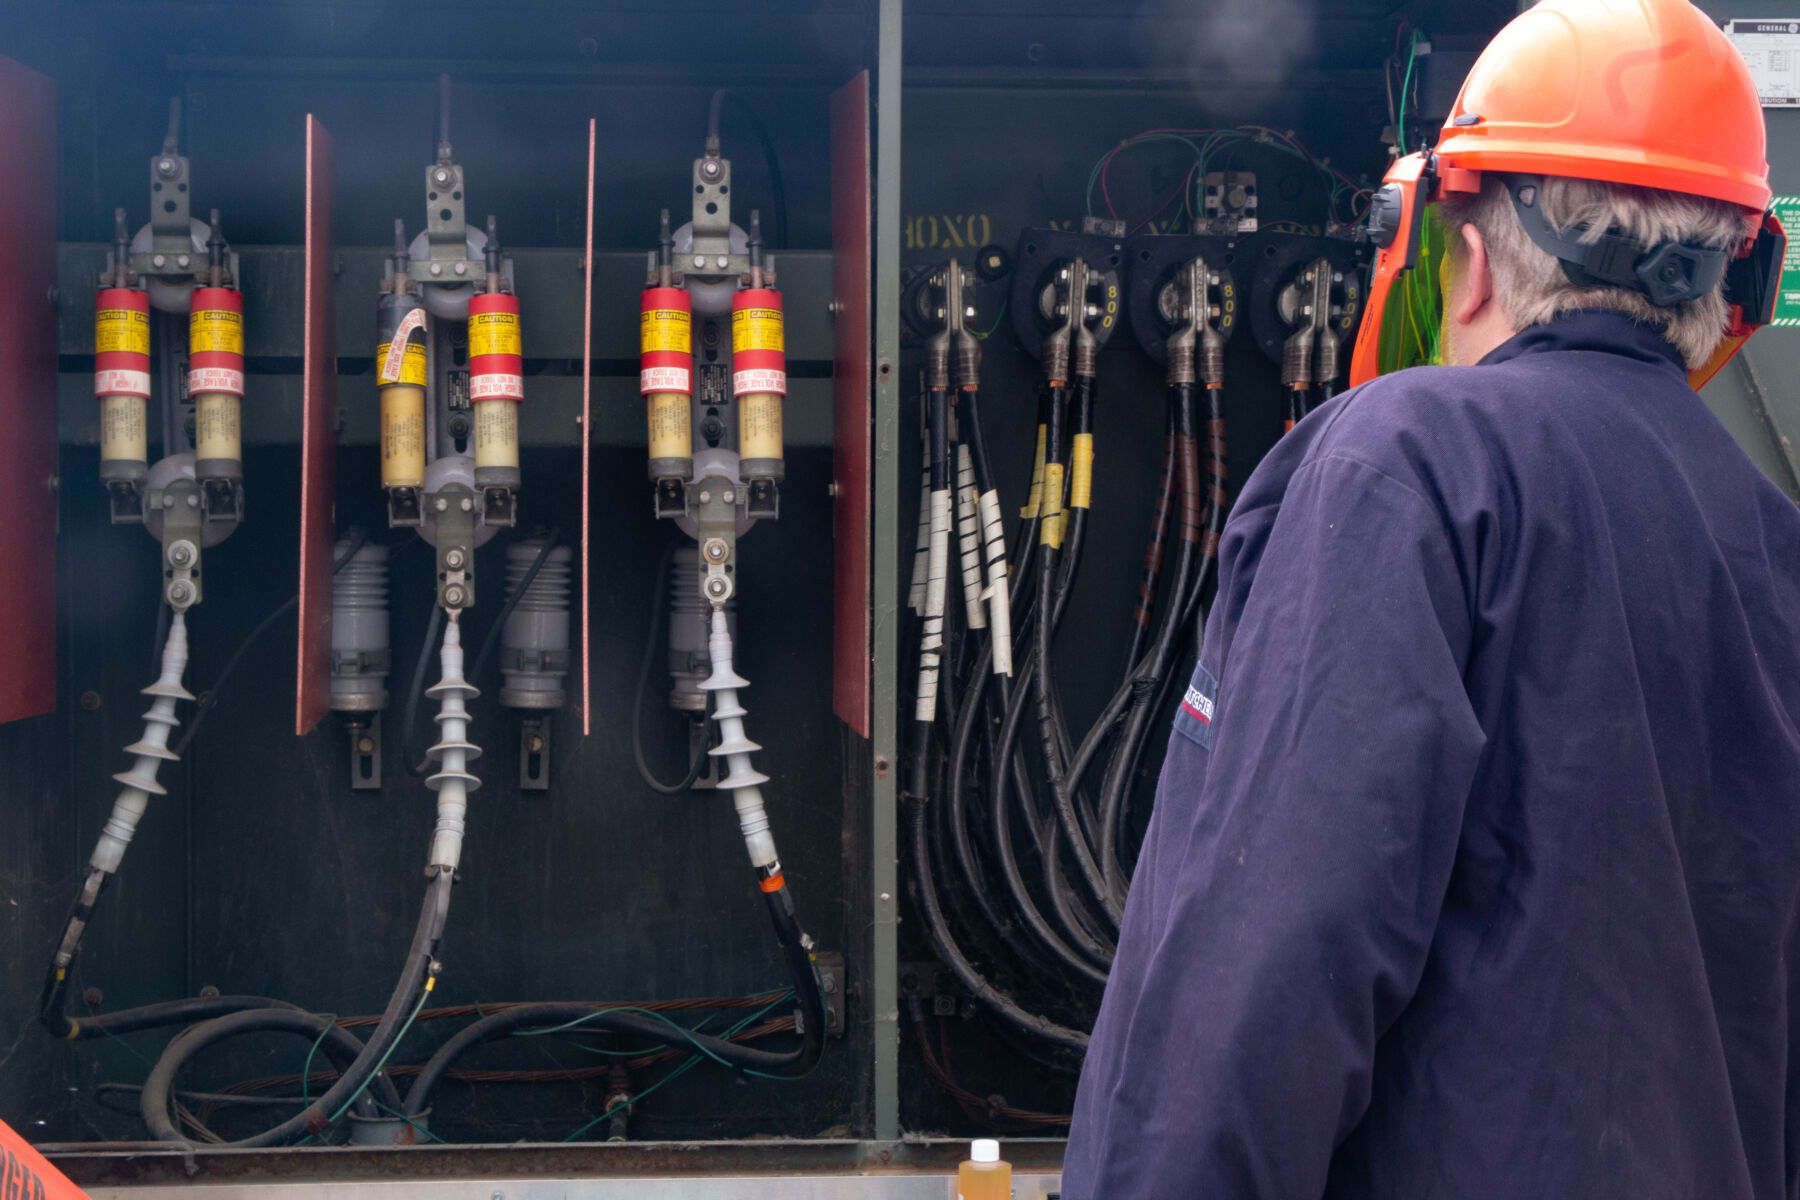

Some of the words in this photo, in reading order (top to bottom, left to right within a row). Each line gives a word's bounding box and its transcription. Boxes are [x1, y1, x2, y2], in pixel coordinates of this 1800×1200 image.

[1757, 24, 1787, 32] GENERAL
[1102, 285, 1118, 328] 800
[1222, 284, 1235, 328] 800
[205, 312, 239, 322] CAUTION
[479, 315, 514, 323] CAUTION
[656, 312, 689, 321] CAUTION
[751, 311, 783, 320] CAUTION
